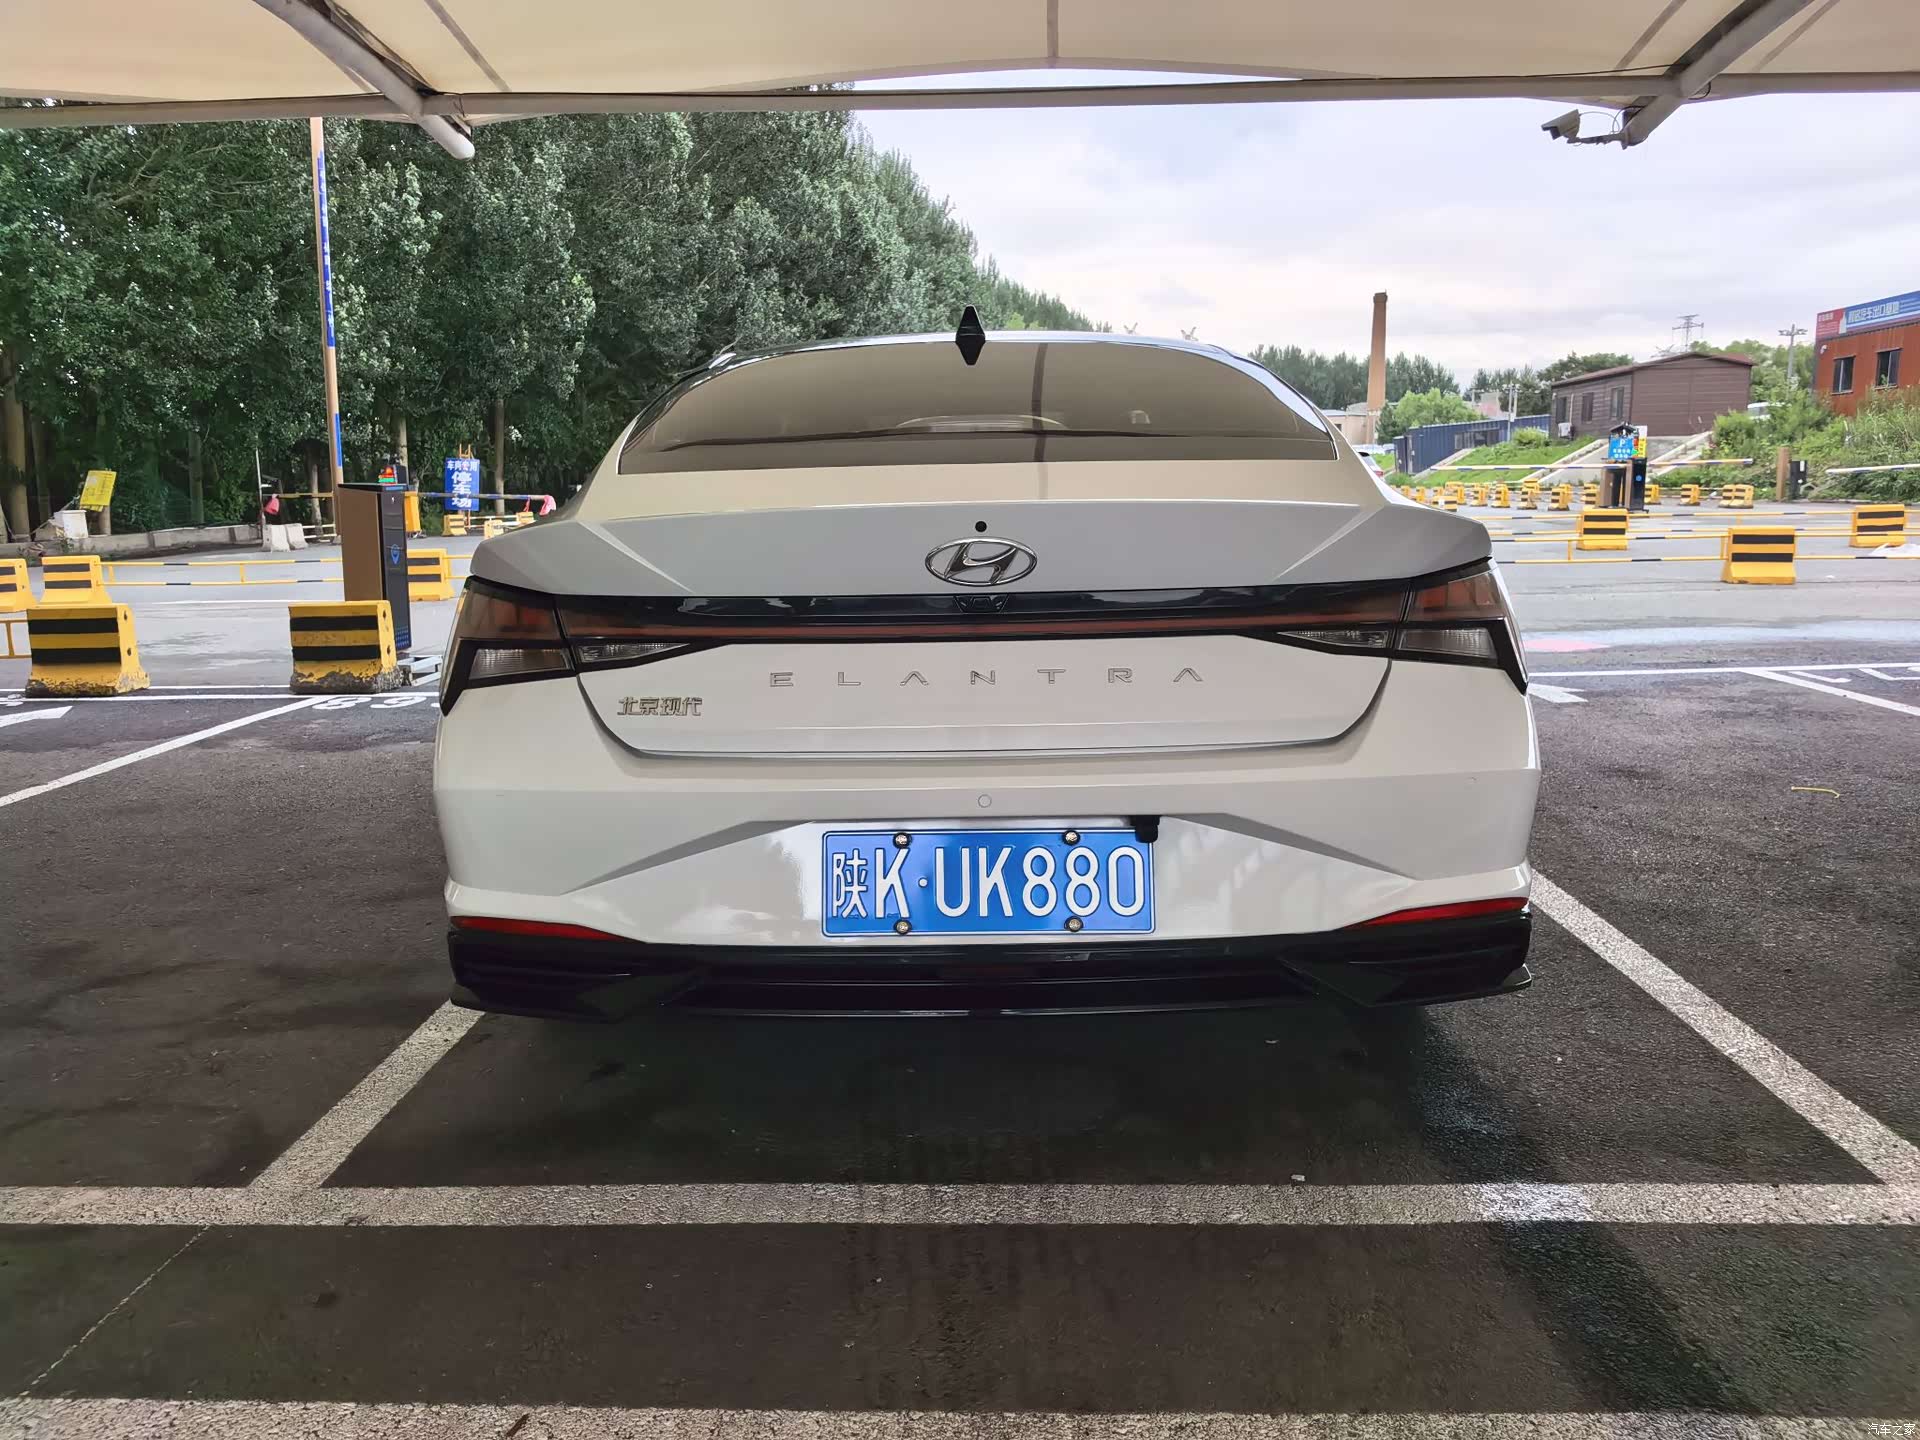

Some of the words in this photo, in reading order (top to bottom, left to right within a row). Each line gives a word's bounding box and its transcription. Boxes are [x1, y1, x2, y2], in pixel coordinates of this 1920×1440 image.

[769, 667, 1203, 687] ELANTRA
[617, 697, 702, 717] 北京现代
[832, 846, 1145, 918] 陕K·UK880
